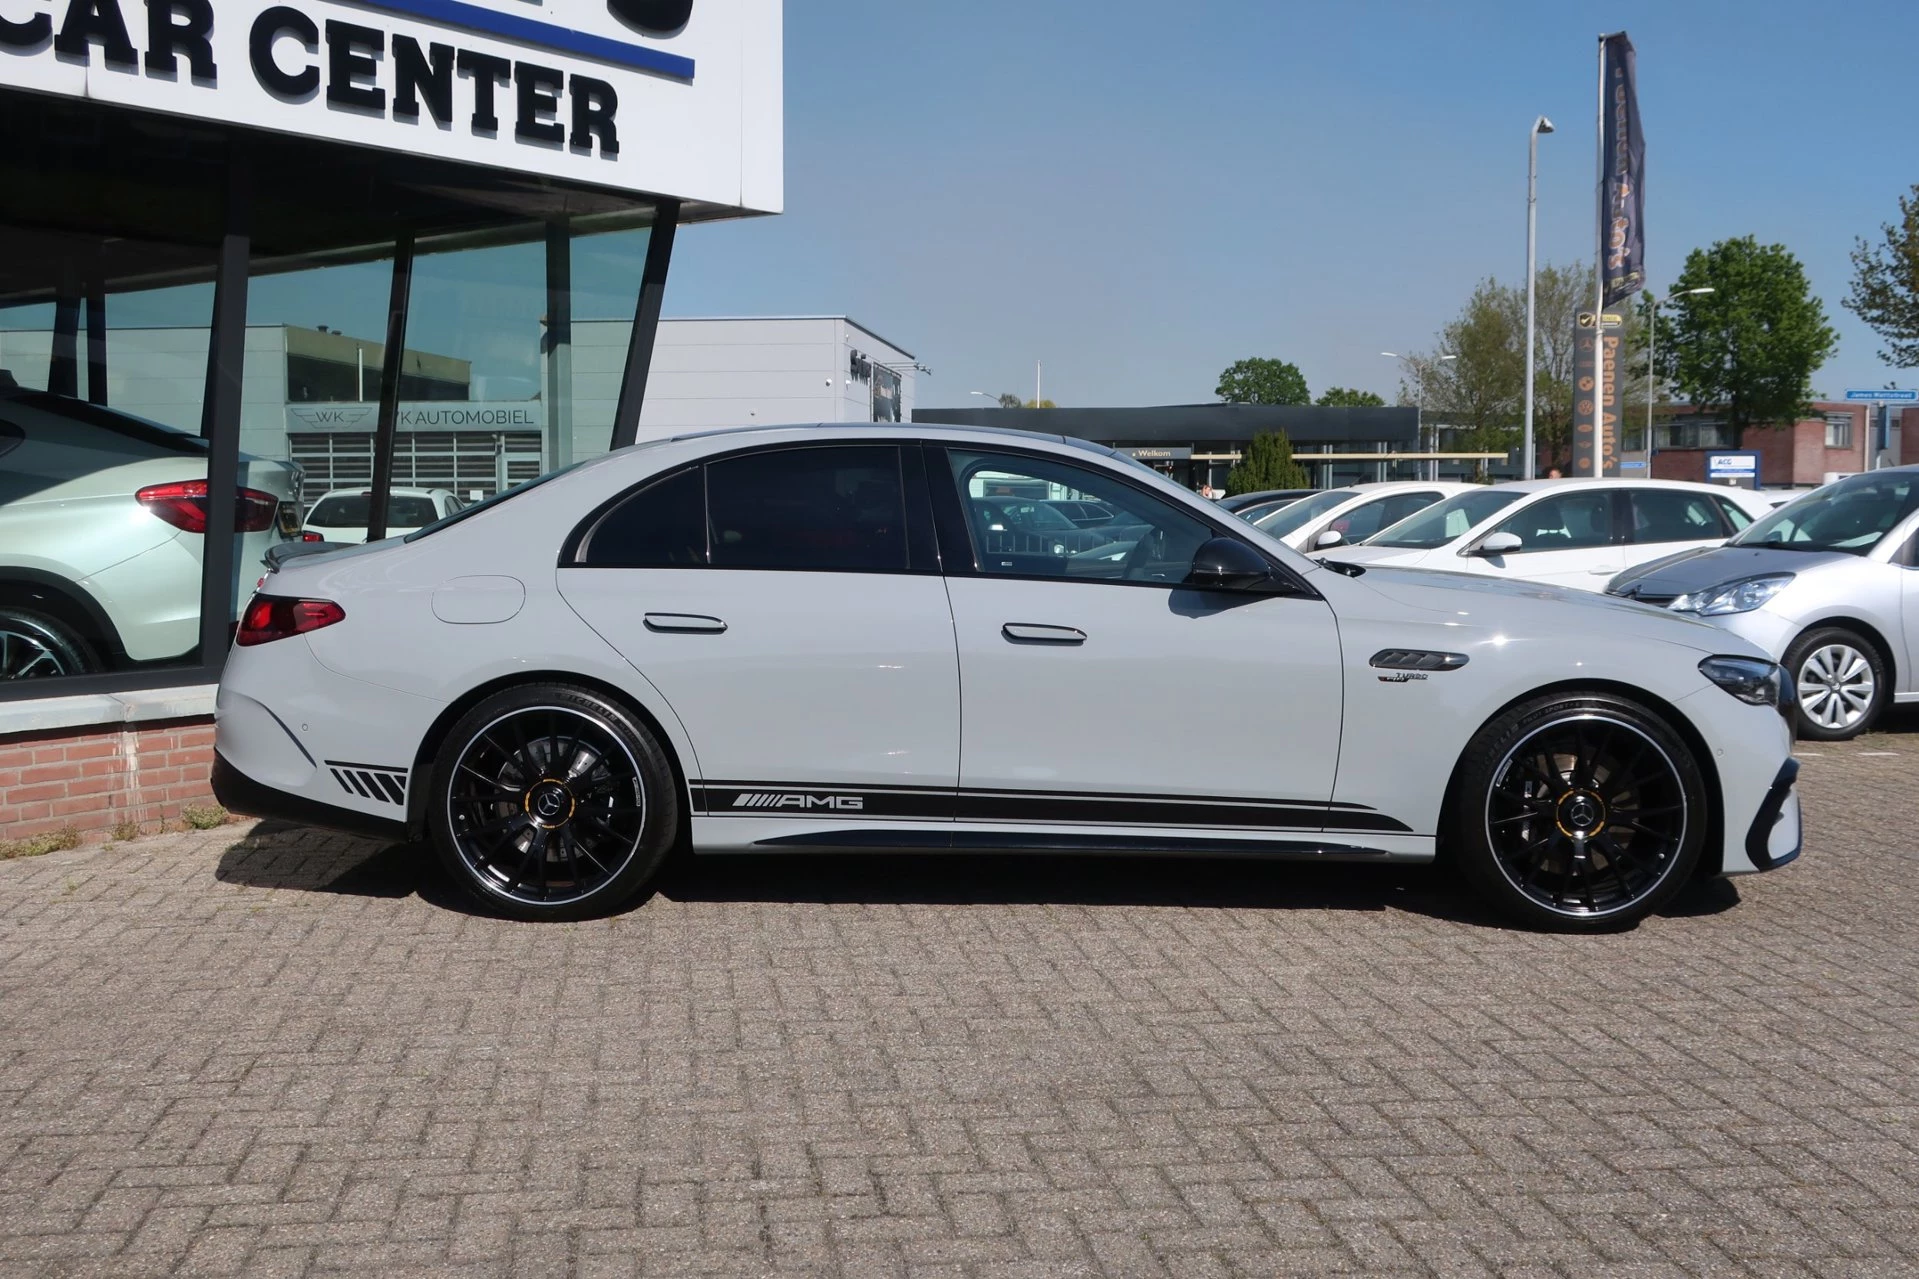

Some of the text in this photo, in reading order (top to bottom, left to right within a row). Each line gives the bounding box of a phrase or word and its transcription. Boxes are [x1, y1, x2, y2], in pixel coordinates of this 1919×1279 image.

[249, 5, 620, 156] CENTER
[315, 410, 344, 424] WK
[397, 409, 534, 425] K AUTOMOBIEL
[774, 794, 863, 810] AMG
